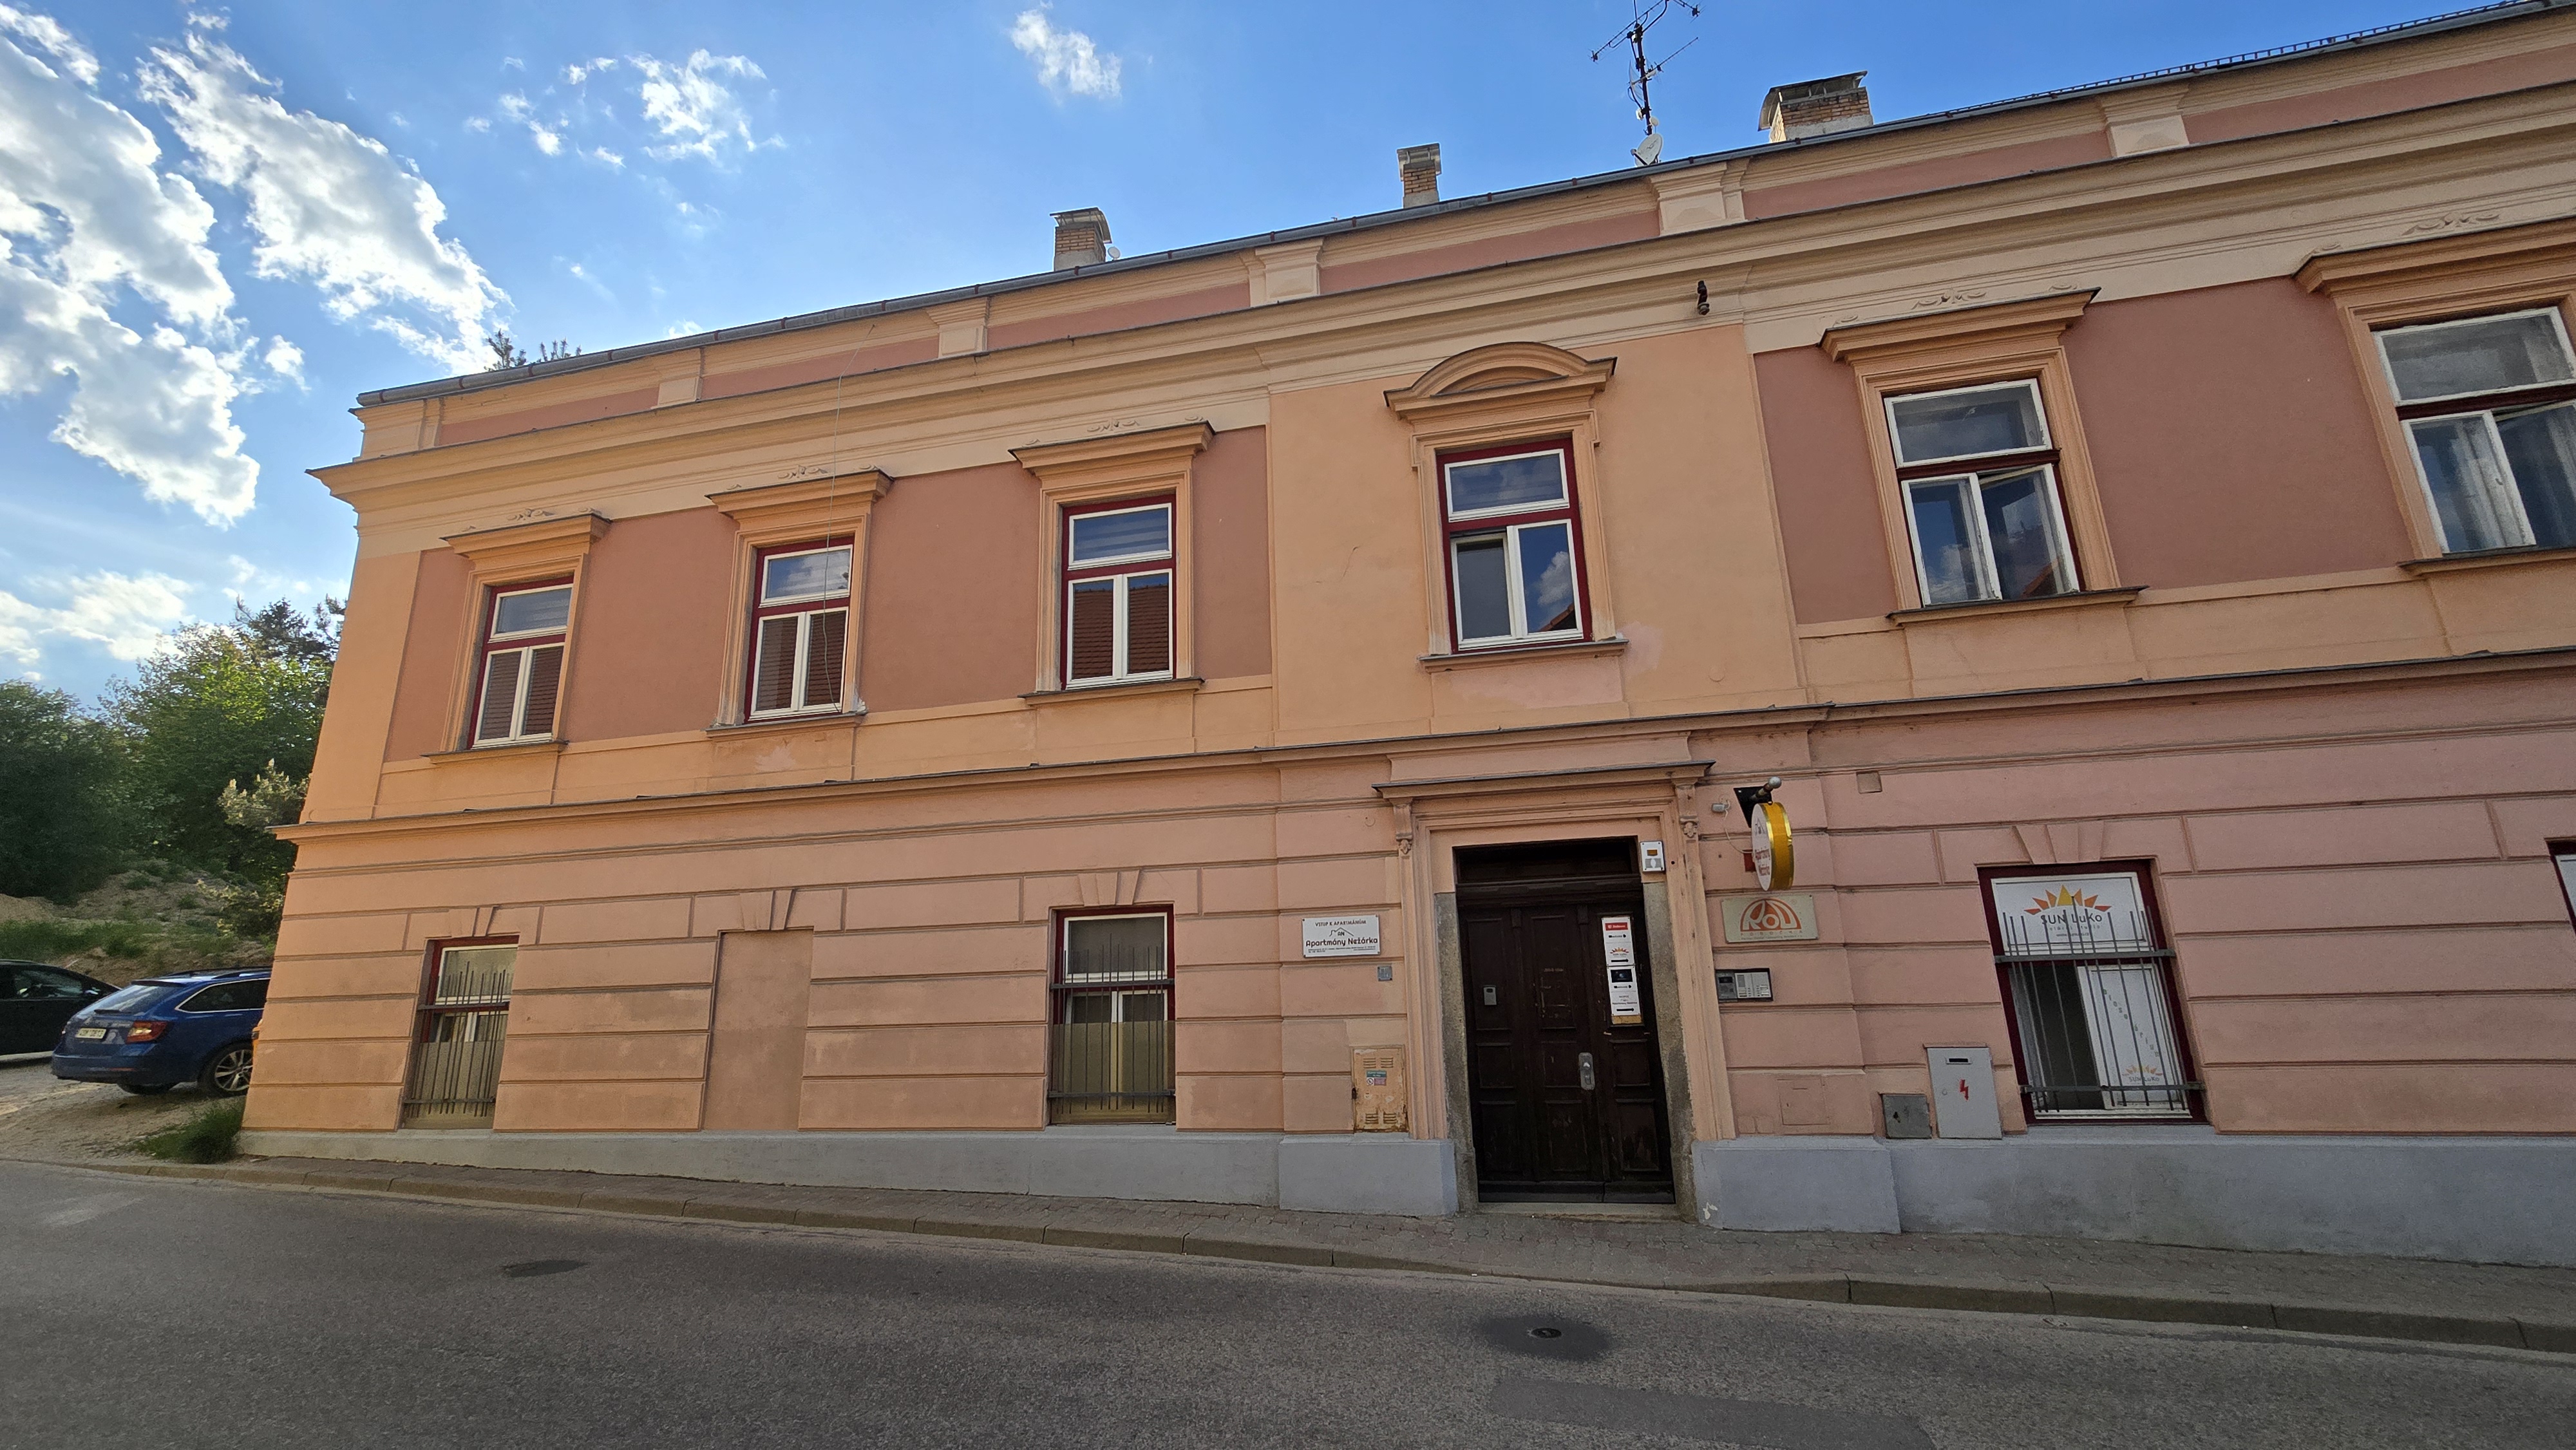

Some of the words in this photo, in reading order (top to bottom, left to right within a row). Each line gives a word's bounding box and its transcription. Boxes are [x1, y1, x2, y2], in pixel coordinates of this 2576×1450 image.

[2040, 914, 2067, 925] SUN
[1305, 937, 1346, 948] Apartmány
[1348, 937, 1378, 945] Nežárka
